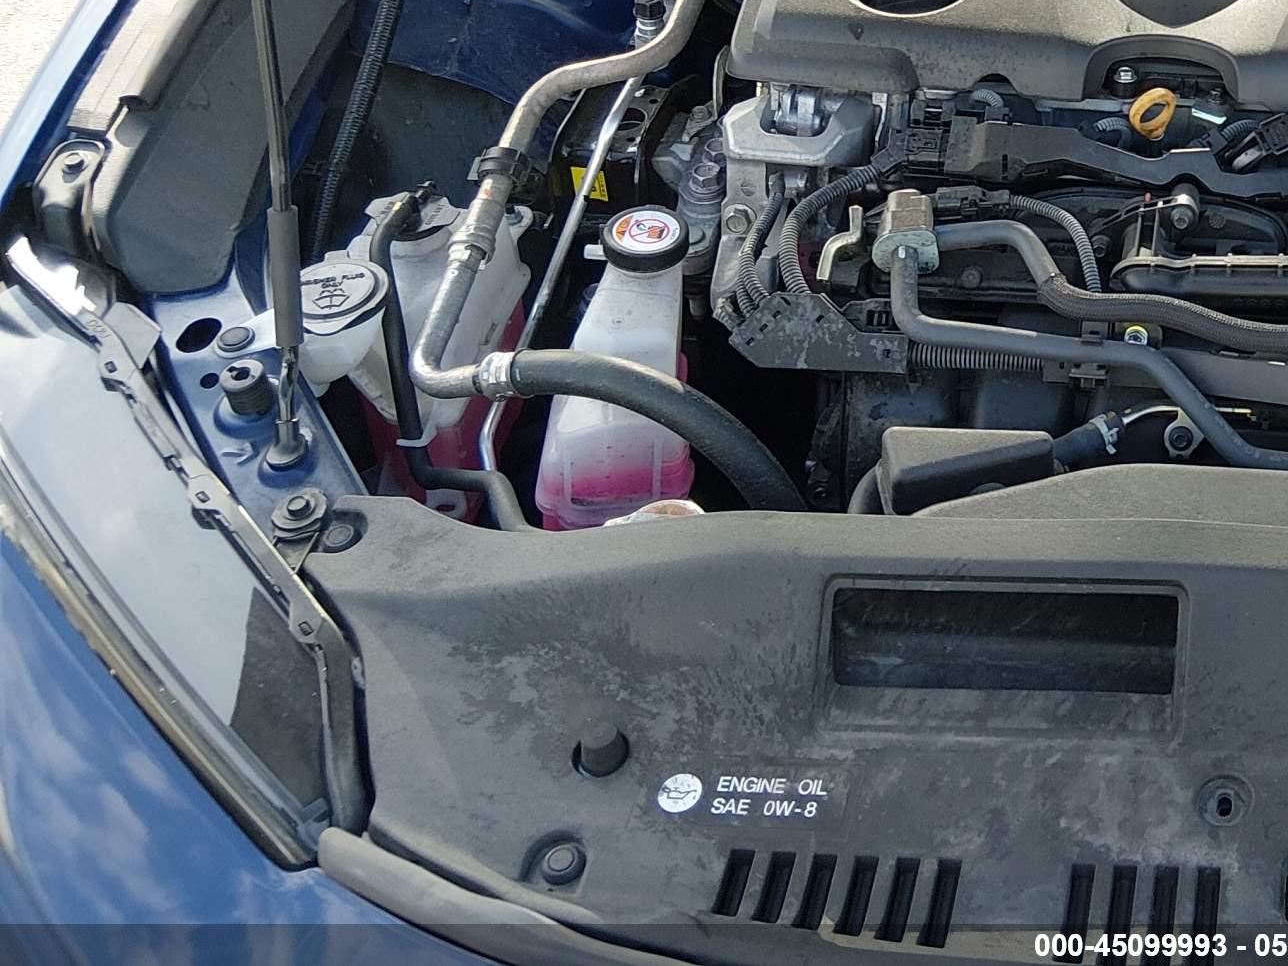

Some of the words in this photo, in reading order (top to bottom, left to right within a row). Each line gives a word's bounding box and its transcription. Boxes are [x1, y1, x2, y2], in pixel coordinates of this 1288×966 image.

[716, 776, 787, 794] ENGINE
[797, 778, 828, 796] OIL
[711, 797, 751, 816] SAE
[763, 800, 818, 818] 0W-8
